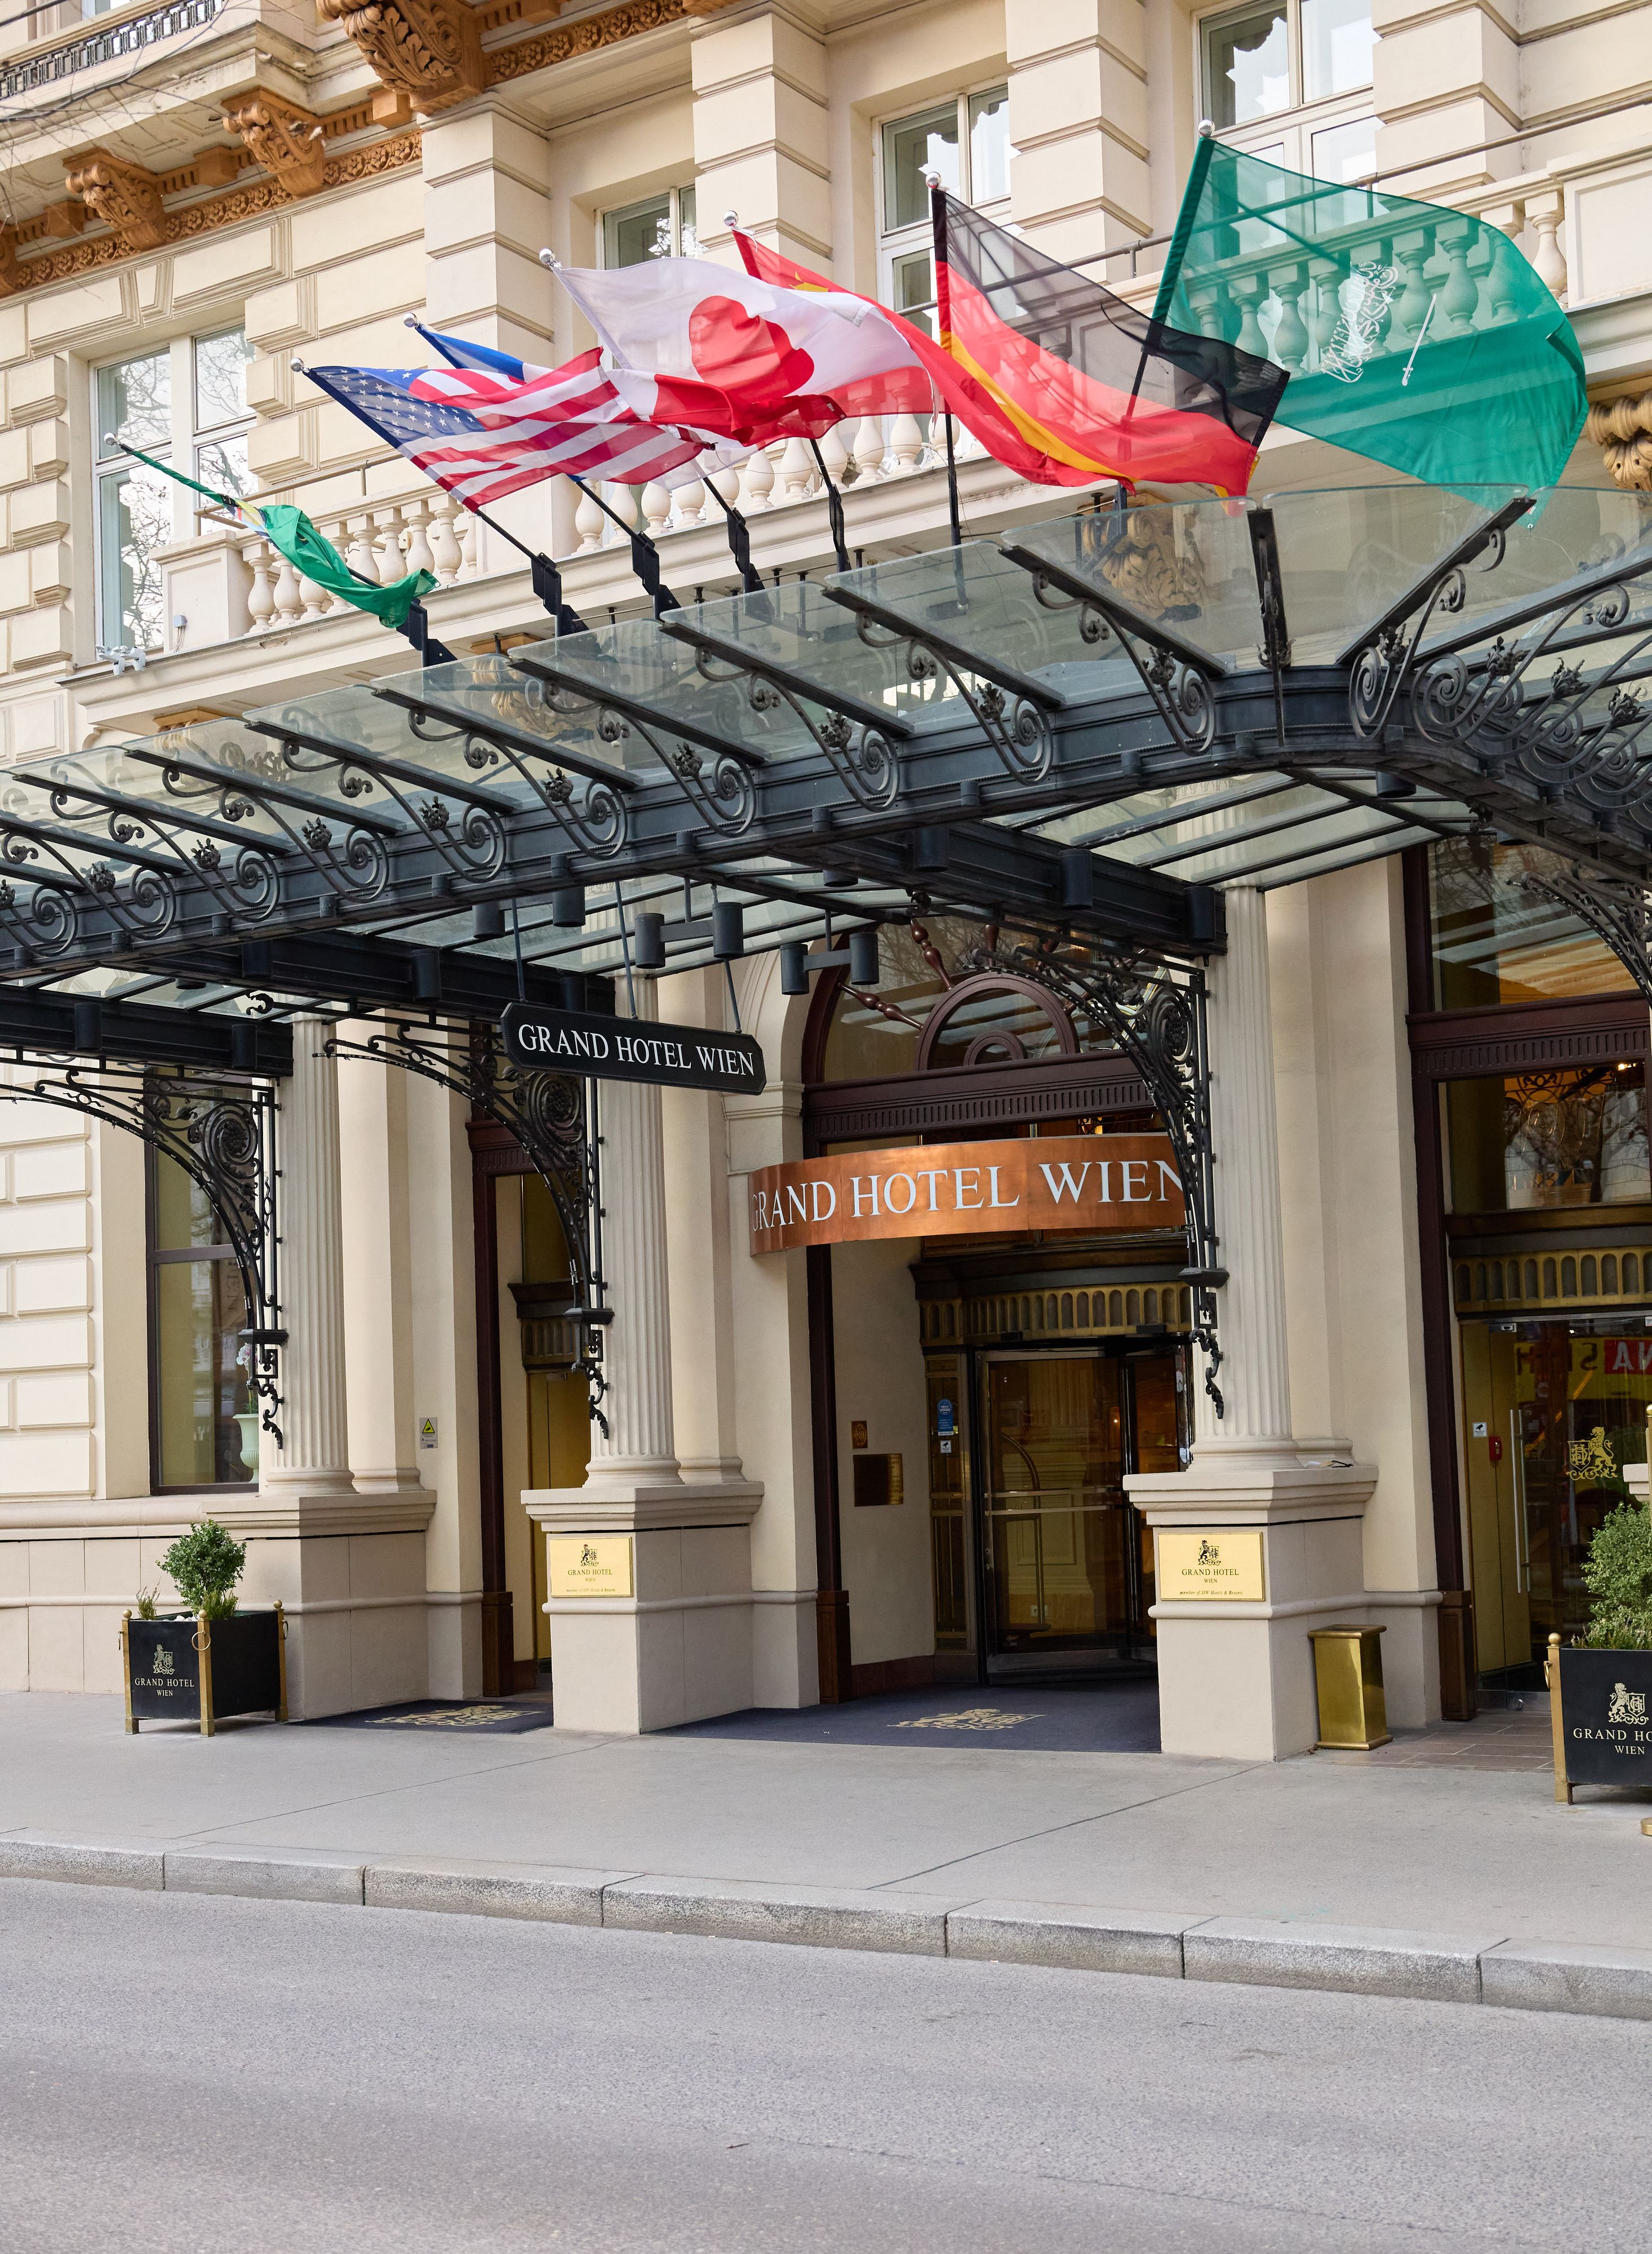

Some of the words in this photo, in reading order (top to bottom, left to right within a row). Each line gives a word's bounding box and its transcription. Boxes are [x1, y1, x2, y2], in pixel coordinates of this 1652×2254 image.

[518, 1023, 609, 1059] GRAND
[614, 1035, 692, 1070] HOTEL
[695, 1045, 755, 1077] WIEN
[751, 1181, 836, 1232] GRAND
[851, 1165, 1020, 1218] HOTEL
[1038, 1160, 1185, 1205] WIEN
[135, 1678, 163, 1687] GRAND
[167, 1679, 195, 1687] HOTEL
[1573, 1728, 1627, 1741] GRAND
[1614, 1745, 1645, 1755] WIEN
